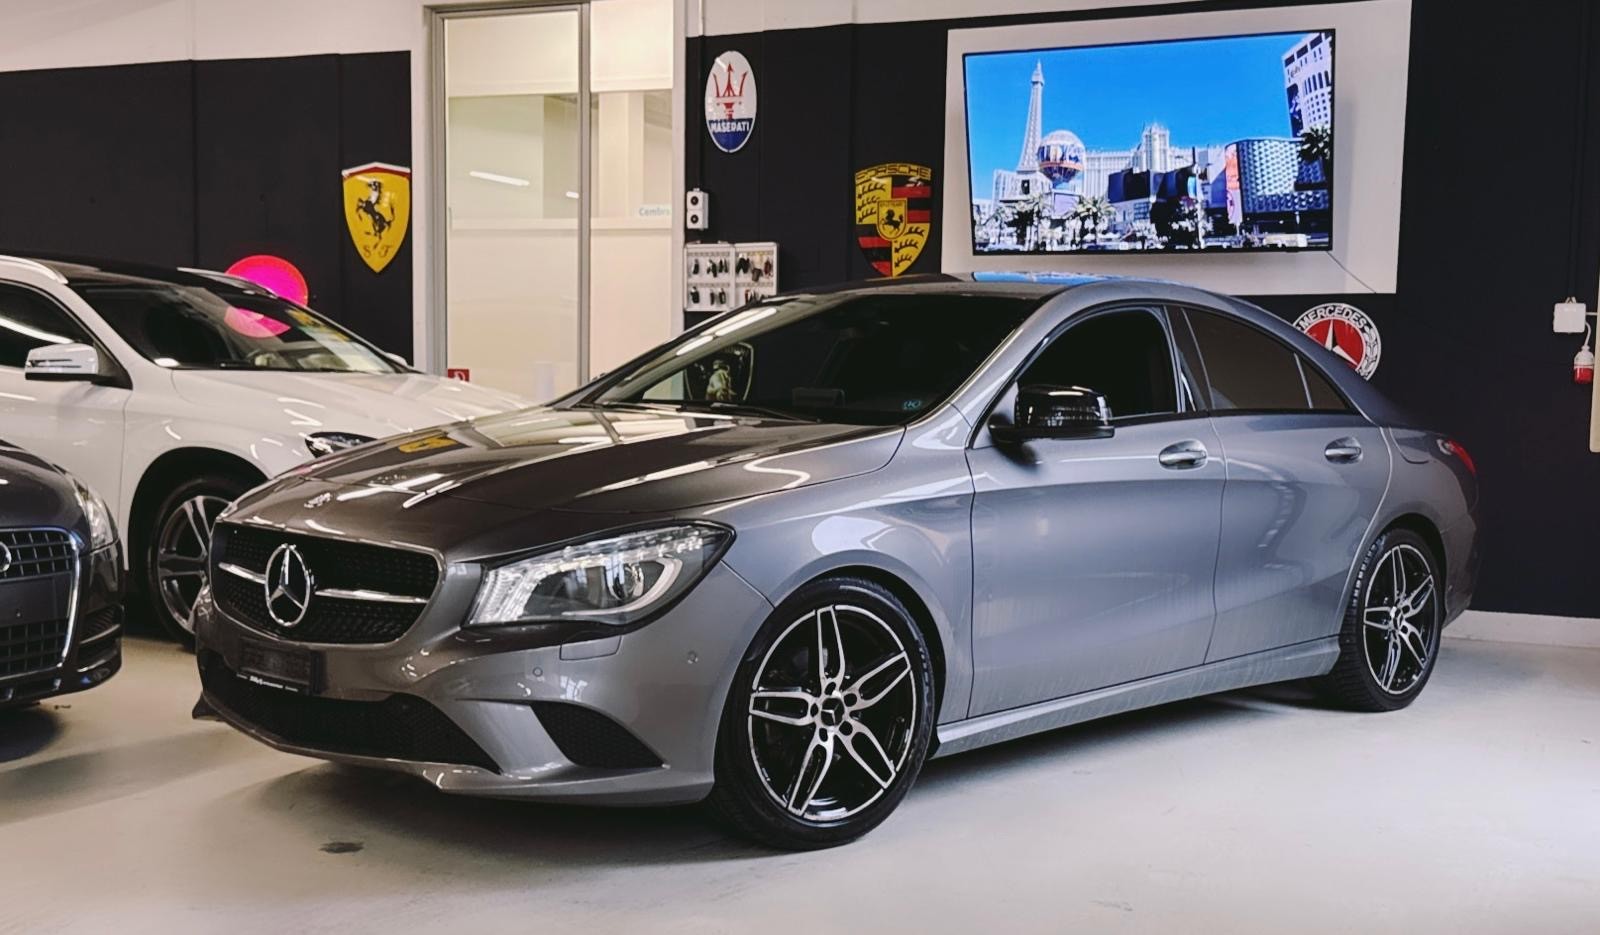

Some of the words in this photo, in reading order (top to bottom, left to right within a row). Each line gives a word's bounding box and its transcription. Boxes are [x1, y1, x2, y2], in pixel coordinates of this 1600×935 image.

[710, 121, 750, 133] MASERATI
[856, 164, 930, 181] PORSCHE
[1299, 306, 1367, 330] MERCEDES
